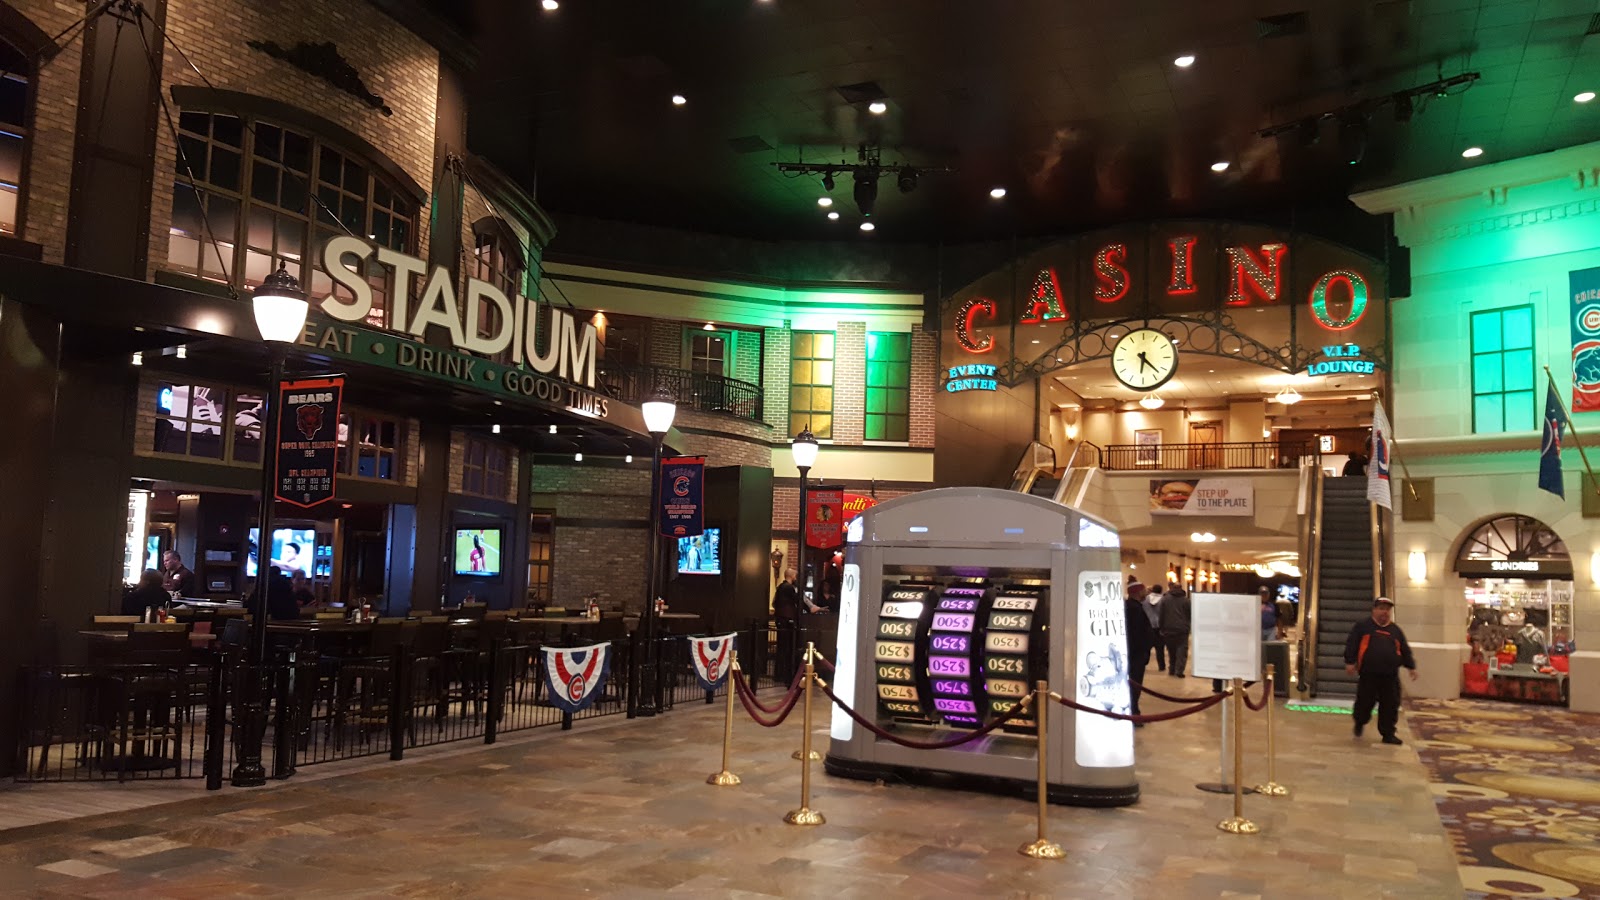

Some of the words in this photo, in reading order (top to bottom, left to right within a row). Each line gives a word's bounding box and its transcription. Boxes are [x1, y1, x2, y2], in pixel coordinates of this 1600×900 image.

[953, 235, 1370, 354] CASINO
[319, 235, 598, 389] STADIUM
[1321, 344, 1360, 358] V.I.P.
[299, 321, 358, 354] EAT
[397, 342, 476, 383] DRINK
[503, 370, 562, 402] GOOD
[569, 387, 608, 419] TIMES
[948, 364, 997, 379] EVENT
[1307, 359, 1375, 377] LOUNGE
[946, 378, 997, 393] CENTER
[288, 392, 333, 405] BEARS
[1197, 489, 1216, 498] STEP
[1217, 489, 1228, 498] UP
[1197, 498, 1207, 508] TO
[1208, 498, 1222, 508] THE
[1224, 498, 1247, 508] PLATE
[1491, 561, 1539, 571] SUNDRIES
[892, 591, 924, 600] $500
[941, 599, 974, 610] $250
[997, 600, 1032, 609] $250
[937, 616, 970, 629] $500
[993, 615, 1027, 628] $500
[881, 622, 912, 636] $500
[933, 637, 967, 651] $250
[993, 637, 1020, 648] $250
[878, 644, 911, 658] $250
[932, 659, 966, 673] $250
[988, 658, 1023, 673] $250
[879, 666, 911, 680] $250
[883, 686, 914, 698] $750
[935, 681, 969, 694] $750
[993, 683, 1020, 694] $750
[887, 702, 919, 713] $250
[938, 700, 971, 711] $250
